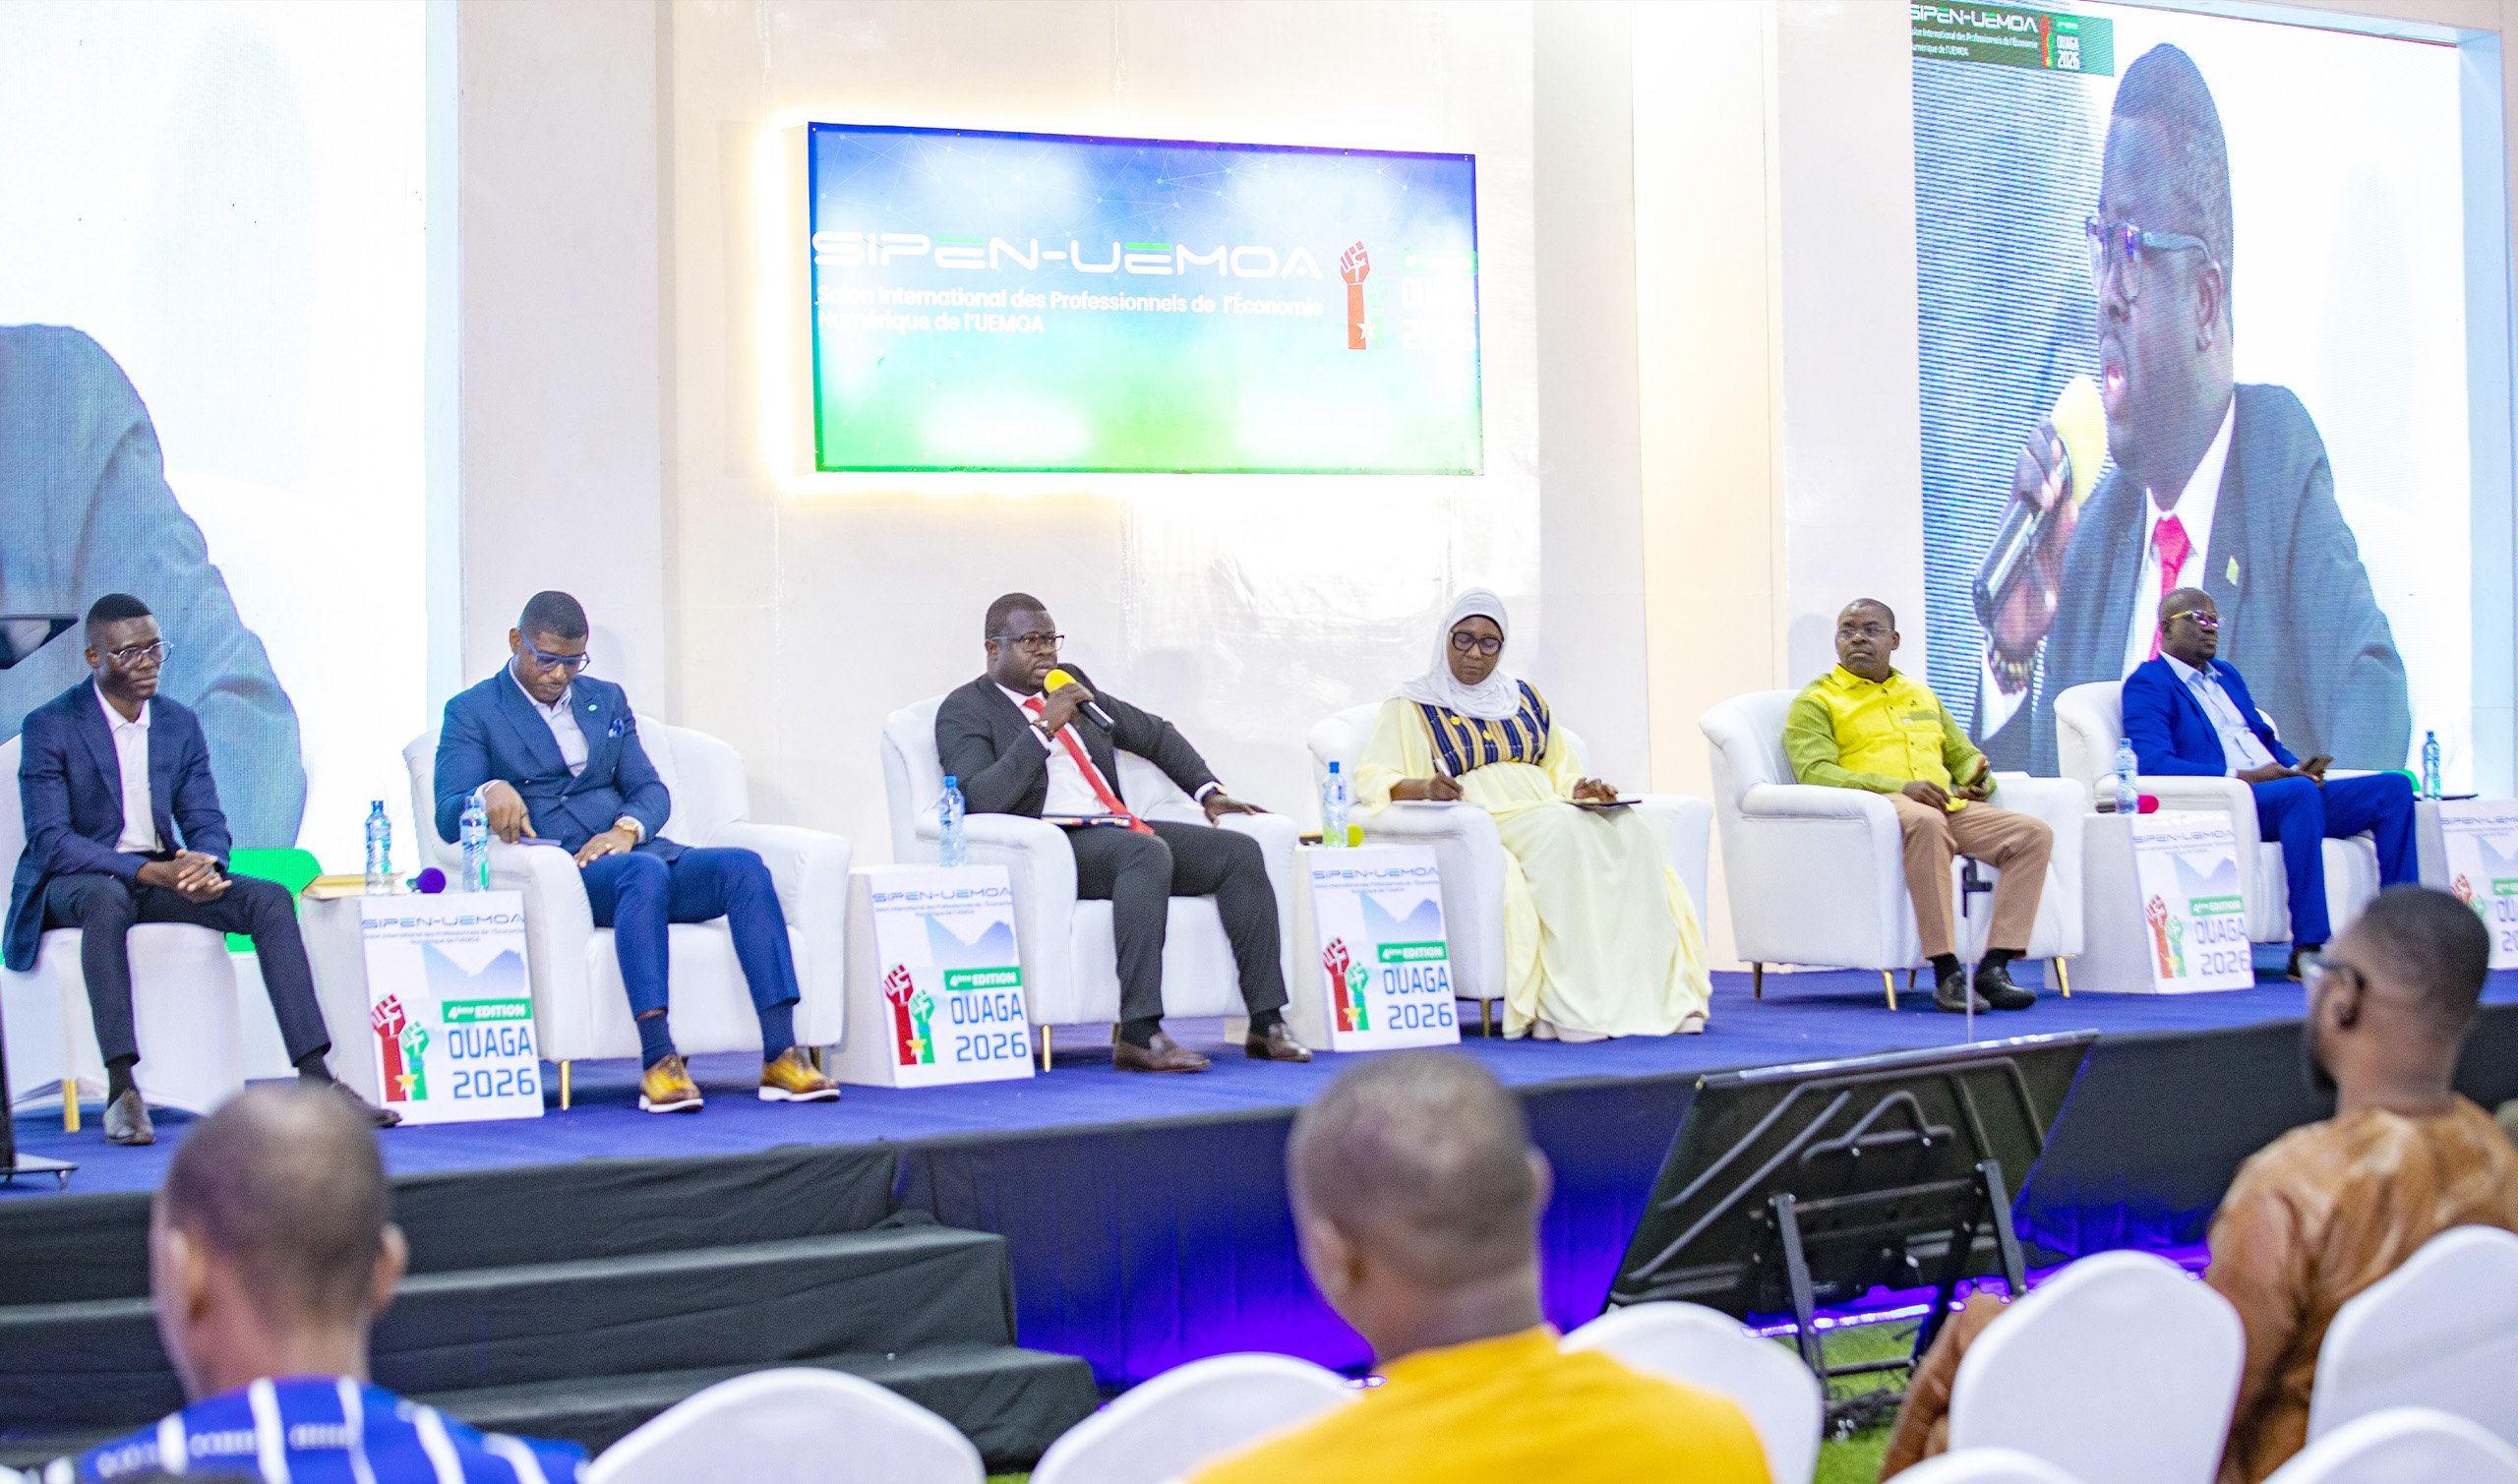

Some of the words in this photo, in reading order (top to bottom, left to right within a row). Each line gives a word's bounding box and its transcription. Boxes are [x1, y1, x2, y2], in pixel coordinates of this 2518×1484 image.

[1910, 3, 2039, 33] SIPEN-UEMOA
[812, 230, 1323, 280] SIPEN-UEMOA
[878, 286, 1007, 309] International
[1010, 289, 1047, 309] des
[1050, 291, 1187, 313] Professionnels
[1191, 294, 1216, 313] de
[1223, 292, 1324, 317] l'Économie
[934, 312, 960, 331] de
[964, 312, 1046, 333] l'UEMOA
[872, 887, 1013, 903] SIPEN-UEMOA
[362, 914, 525, 929] SIPEN-UEMOA
[2193, 917, 2248, 944] OUAGA
[2199, 949, 2251, 976] 2026
[1383, 965, 1450, 995] OUAGA
[474, 1003, 526, 1020] EDITION
[950, 992, 1024, 1025] OUAGA
[1387, 1002, 1454, 1031] 2026
[448, 1026, 533, 1060] OUAGA
[954, 1031, 1028, 1063] 2026
[452, 1067, 536, 1099] 2026
